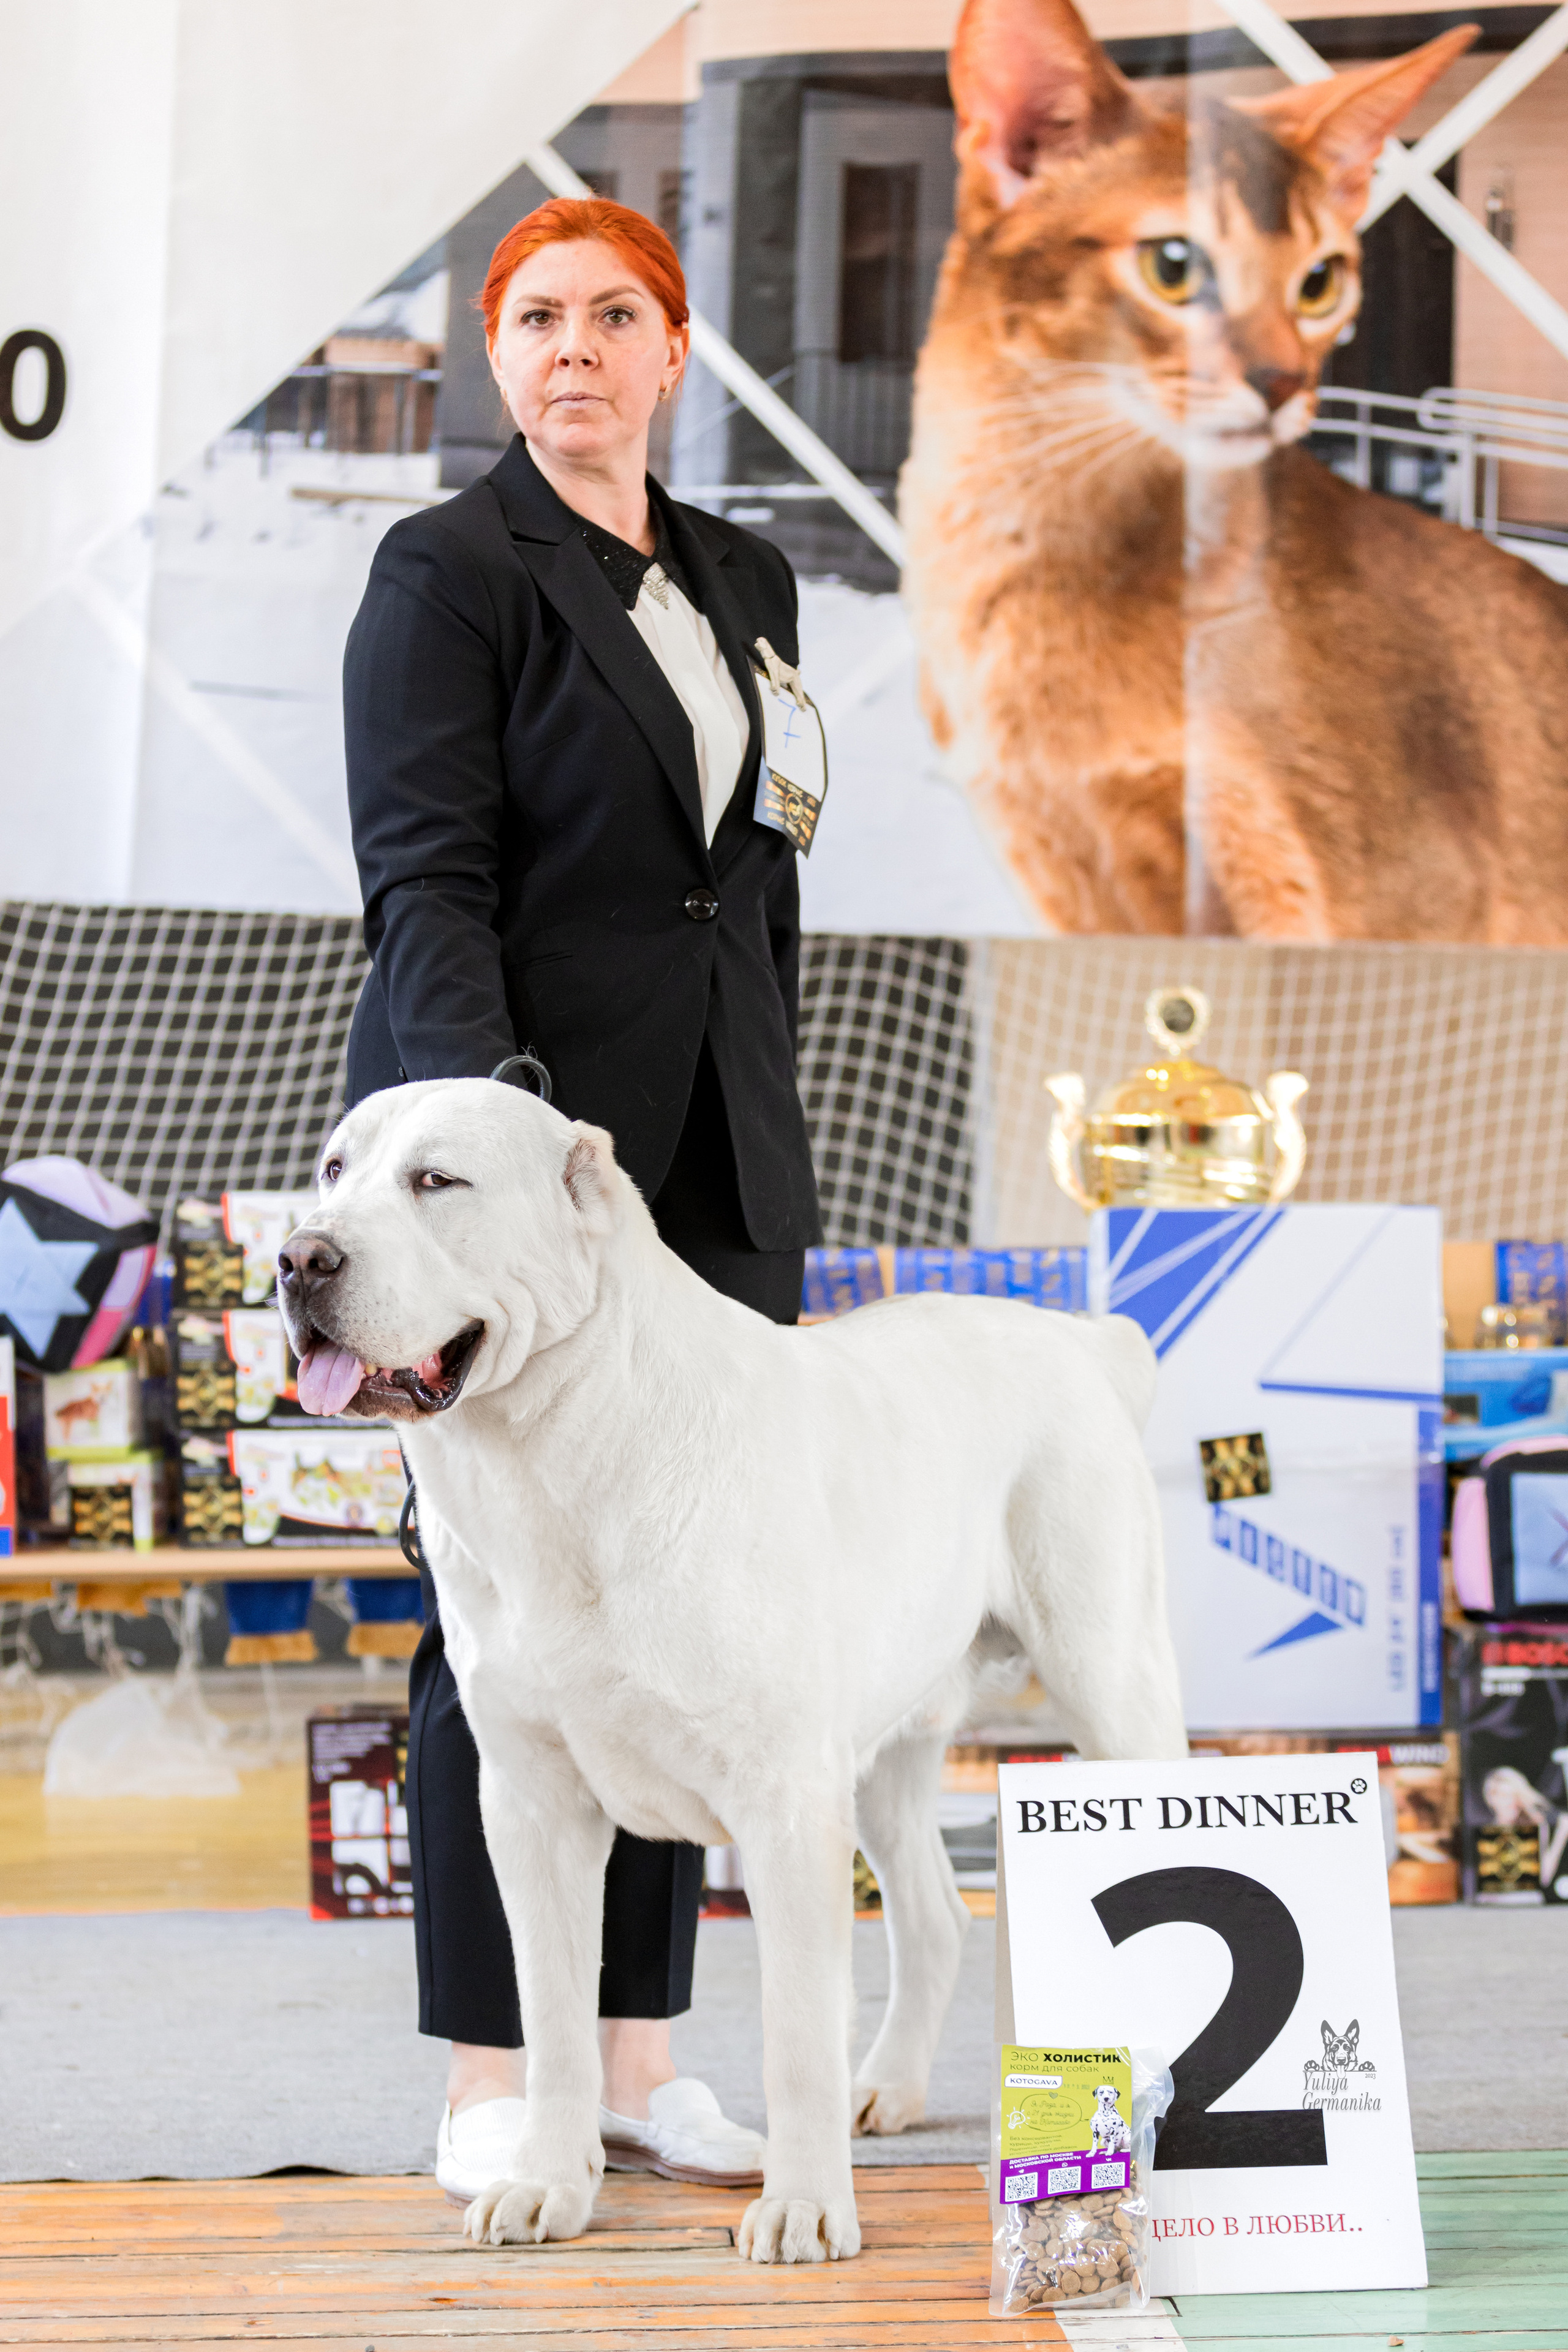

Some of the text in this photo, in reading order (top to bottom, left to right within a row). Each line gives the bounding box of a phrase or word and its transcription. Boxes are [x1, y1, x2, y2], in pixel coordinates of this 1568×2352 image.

[778, 698, 801, 748] 7
[1016, 1792, 1359, 1833] BEST DINNER
[1090, 1866, 1328, 2171] 2
[1010, 2051, 1121, 2063] ЭКО ХОЛИСТИК
[1010, 2064, 1039, 2072] корм
[1009, 2157, 1040, 2165] ДОСТАВКА
[1014, 2158, 1054, 2168] МОСКОВСКОЙ
[1054, 2155, 1082, 2164] ОБЛАСТИ
[1222, 2216, 1239, 2236] В
[1246, 2213, 1363, 2235] ЛЮБВИ..
